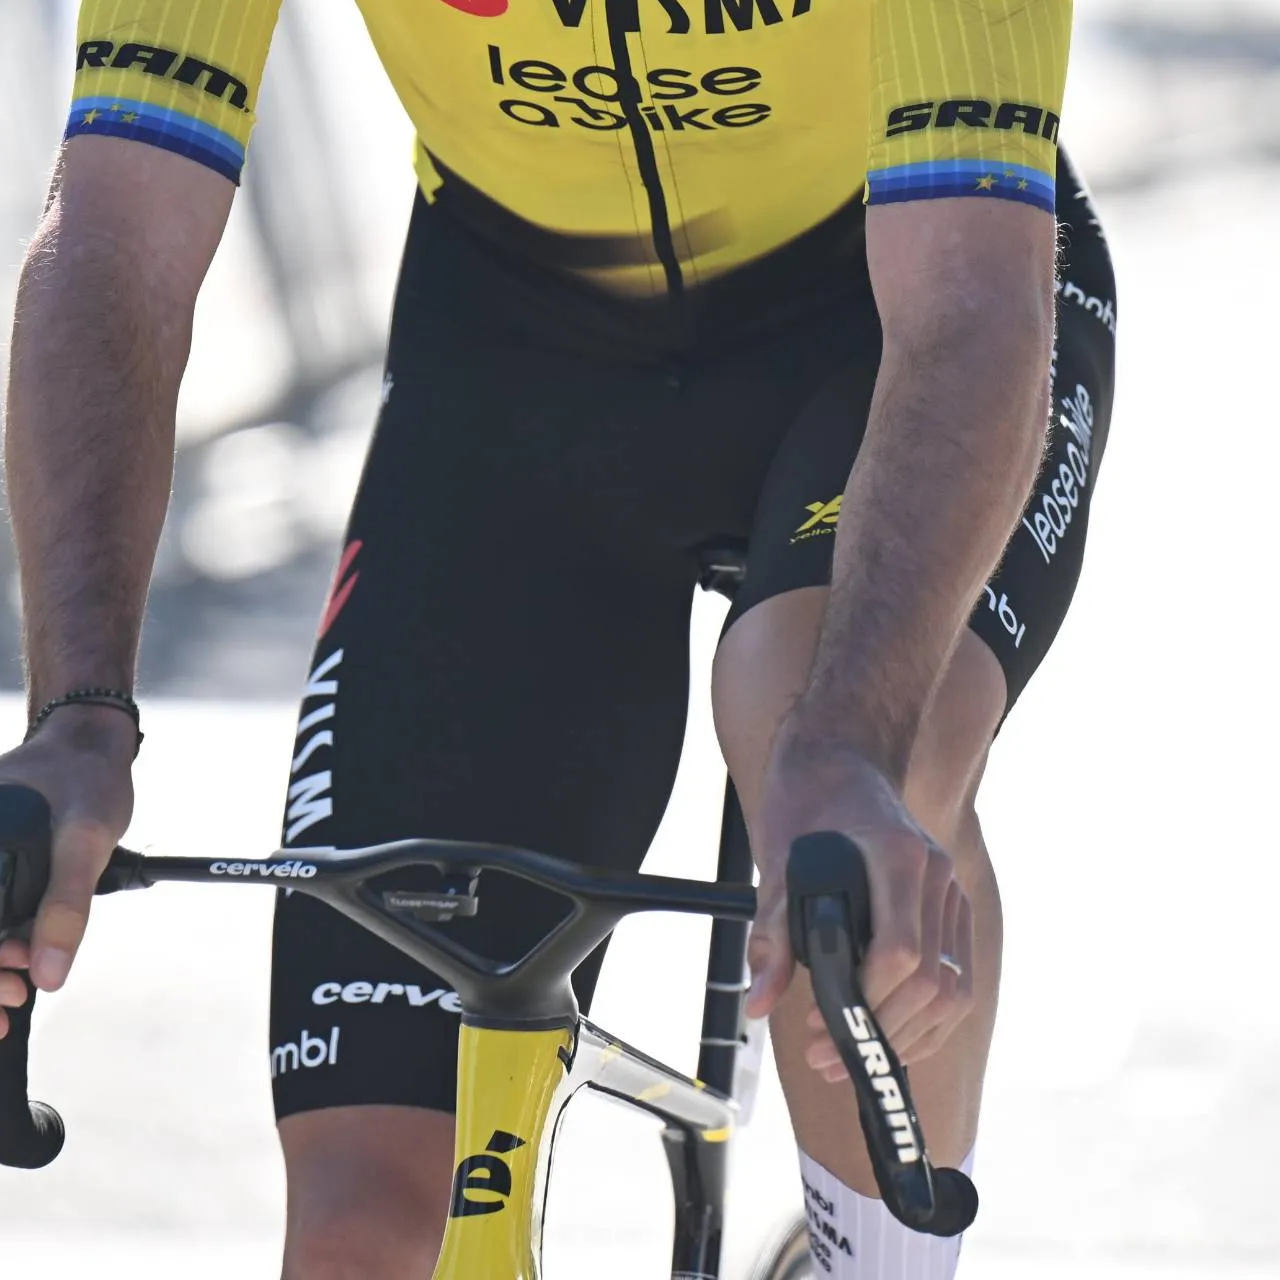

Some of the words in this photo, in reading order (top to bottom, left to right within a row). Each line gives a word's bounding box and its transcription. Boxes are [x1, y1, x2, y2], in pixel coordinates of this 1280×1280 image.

[76, 41, 248, 109] RAM
[487, 45, 762, 104] lease
[286, 648, 345, 846] VISM
[209, 859, 317, 880] cervélo
[271, 1026, 340, 1079] mbl
[842, 1006, 921, 1164] SRAM
